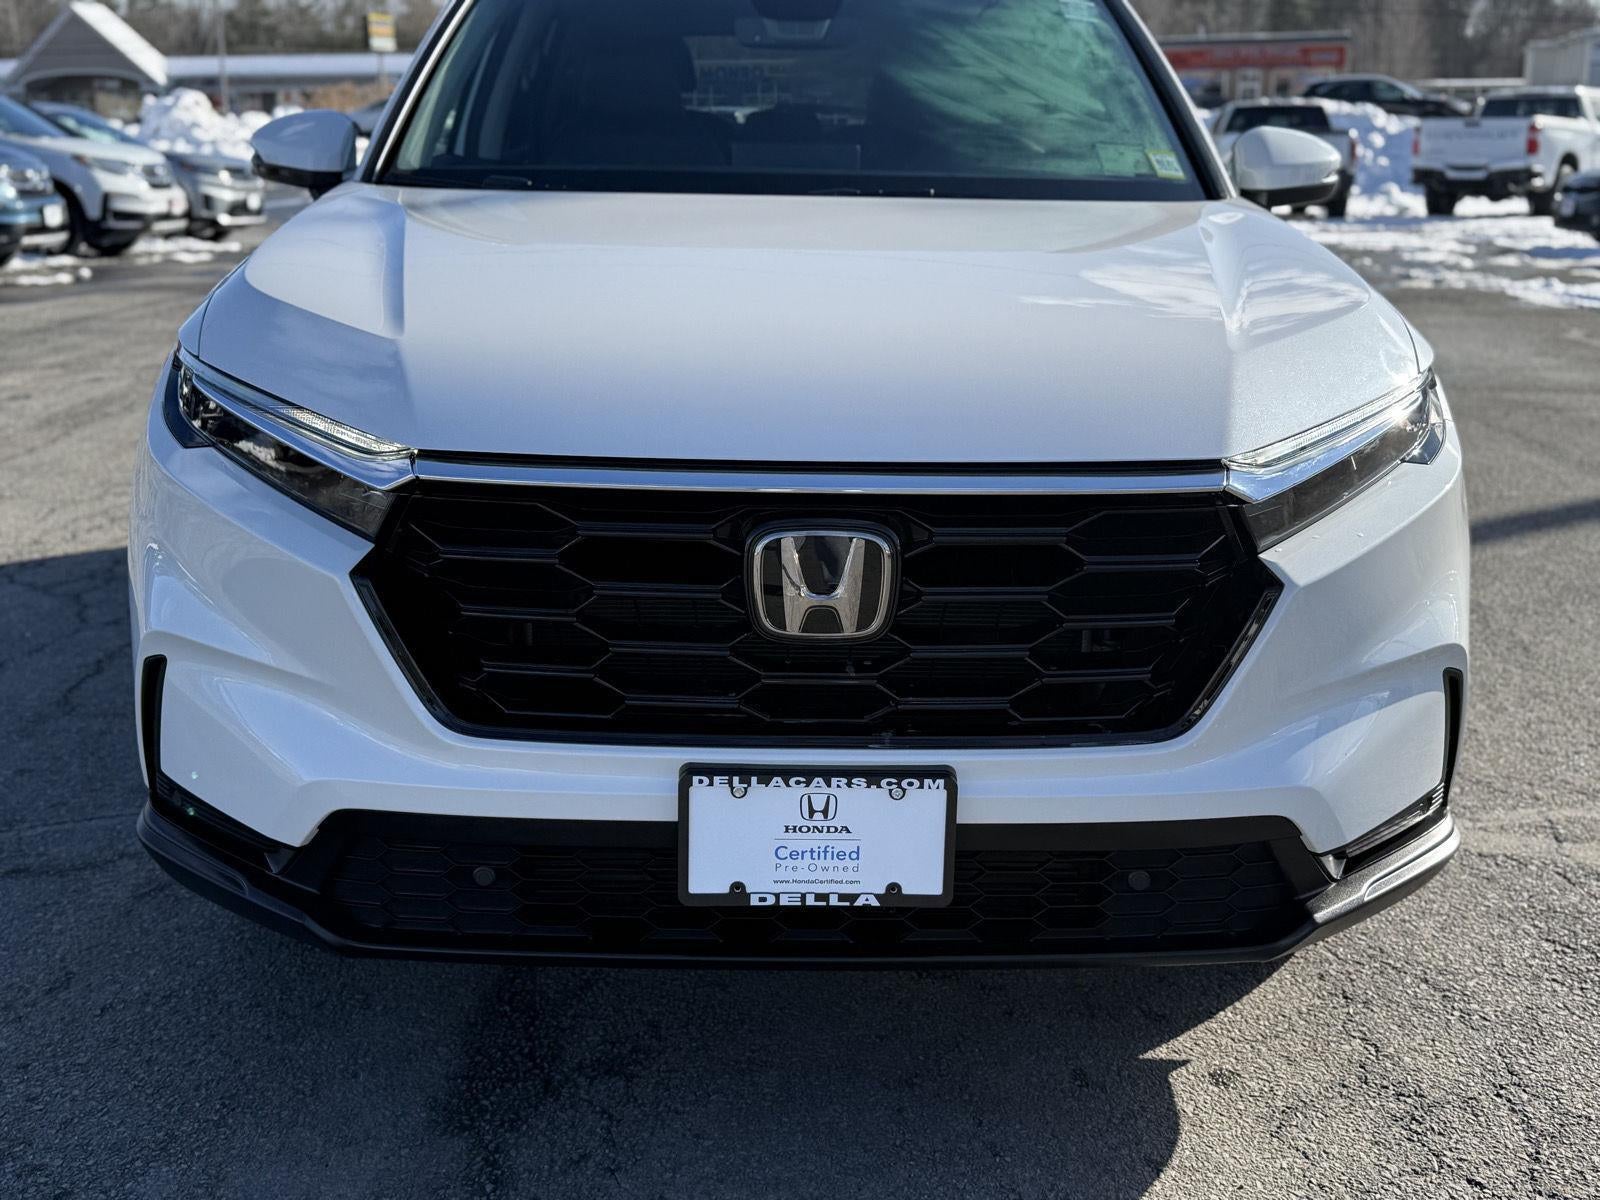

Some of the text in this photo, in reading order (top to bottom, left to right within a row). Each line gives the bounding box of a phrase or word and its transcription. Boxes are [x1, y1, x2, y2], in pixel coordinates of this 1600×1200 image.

[692, 775, 945, 790] DELLACARS.COM
[783, 825, 852, 834] HONDA
[774, 845, 860, 861] Certified
[775, 863, 859, 873] Pre-Owned
[750, 893, 880, 906] DELLA
